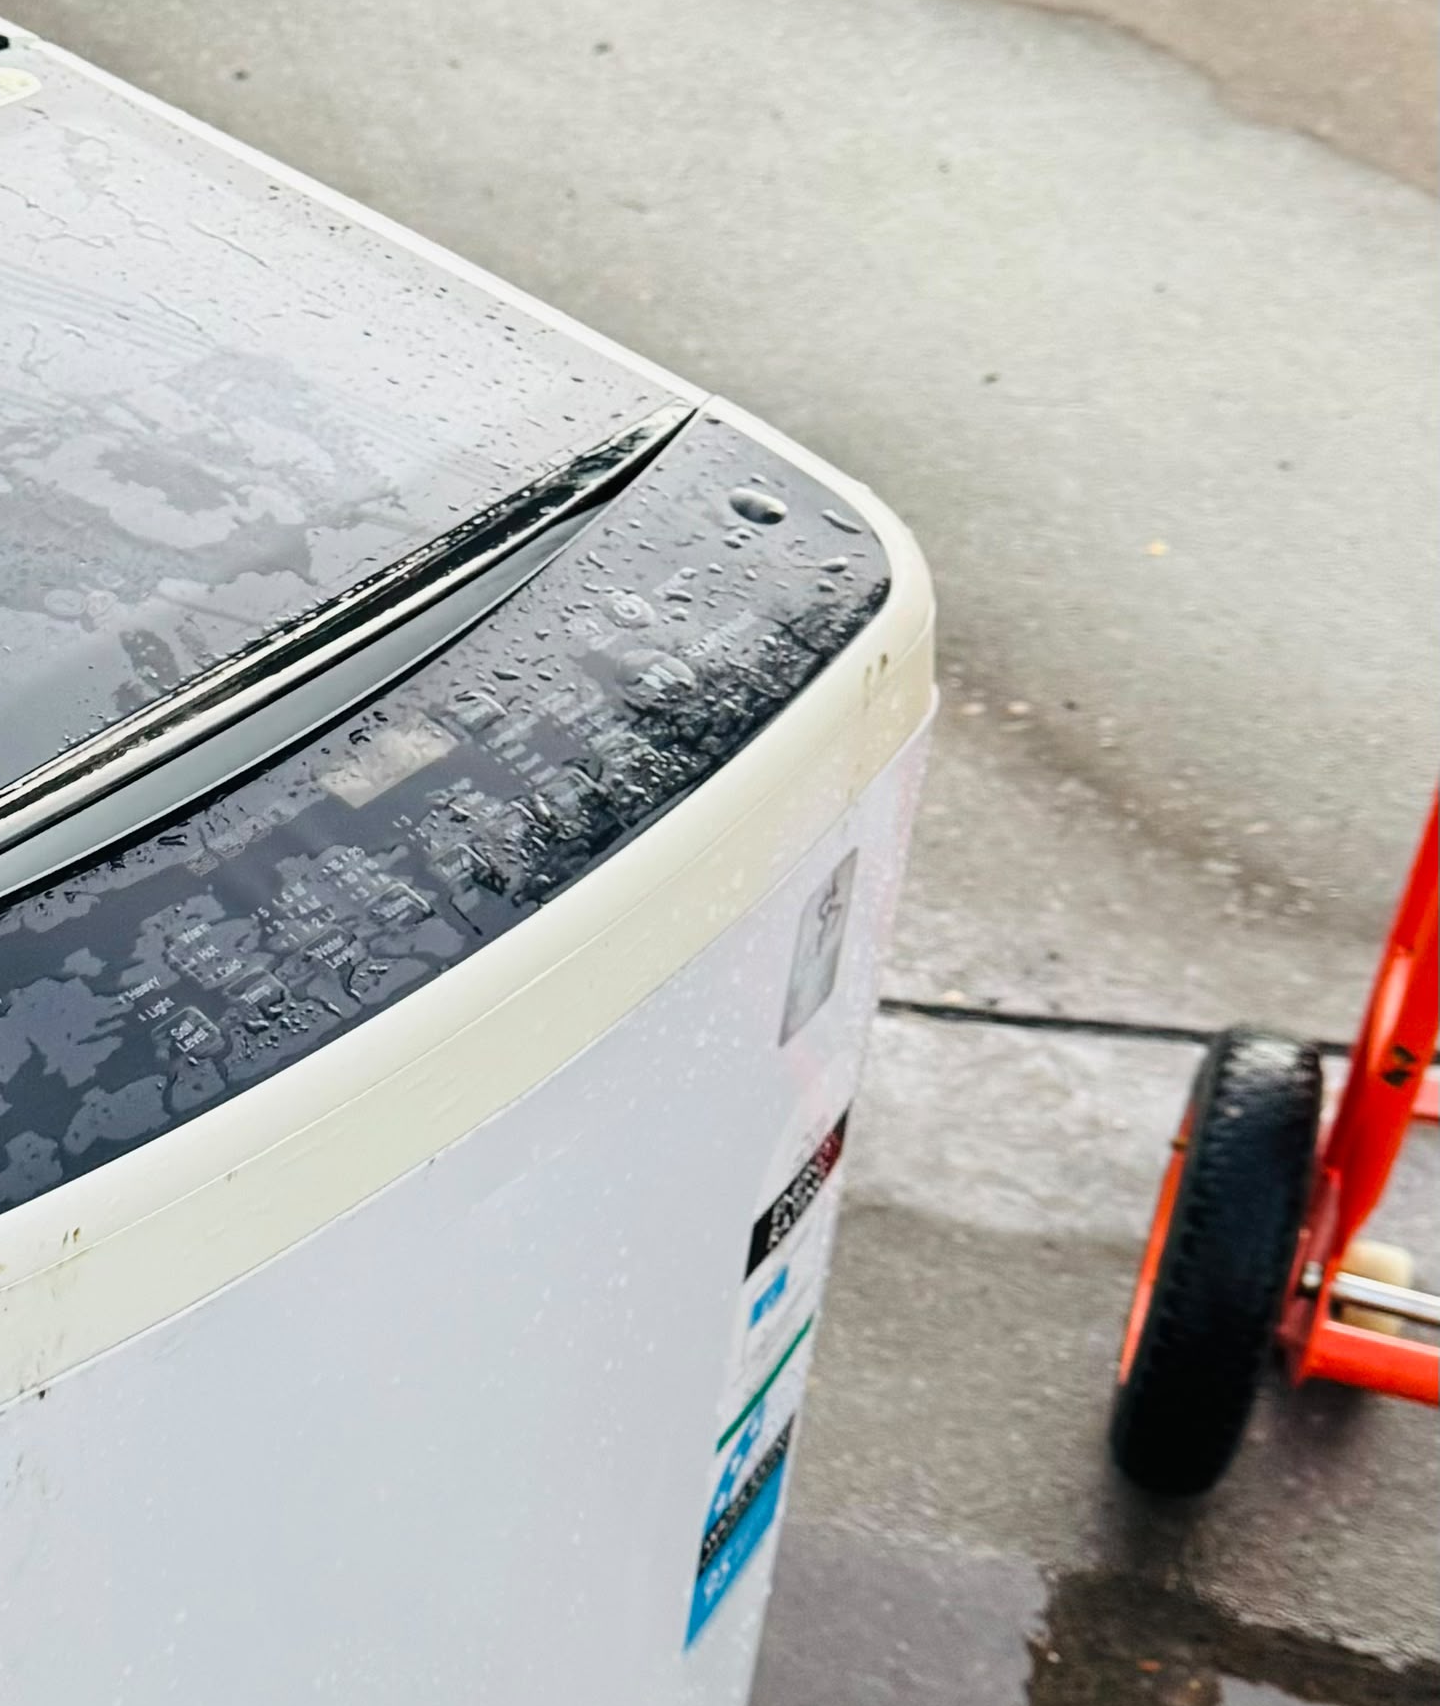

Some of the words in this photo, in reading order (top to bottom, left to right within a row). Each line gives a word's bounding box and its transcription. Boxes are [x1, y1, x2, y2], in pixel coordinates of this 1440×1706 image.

[124, 975, 160, 1001] Heavy
[145, 996, 176, 1019] Light
[170, 1019, 194, 1041] Soil
[175, 1026, 209, 1053] Level
